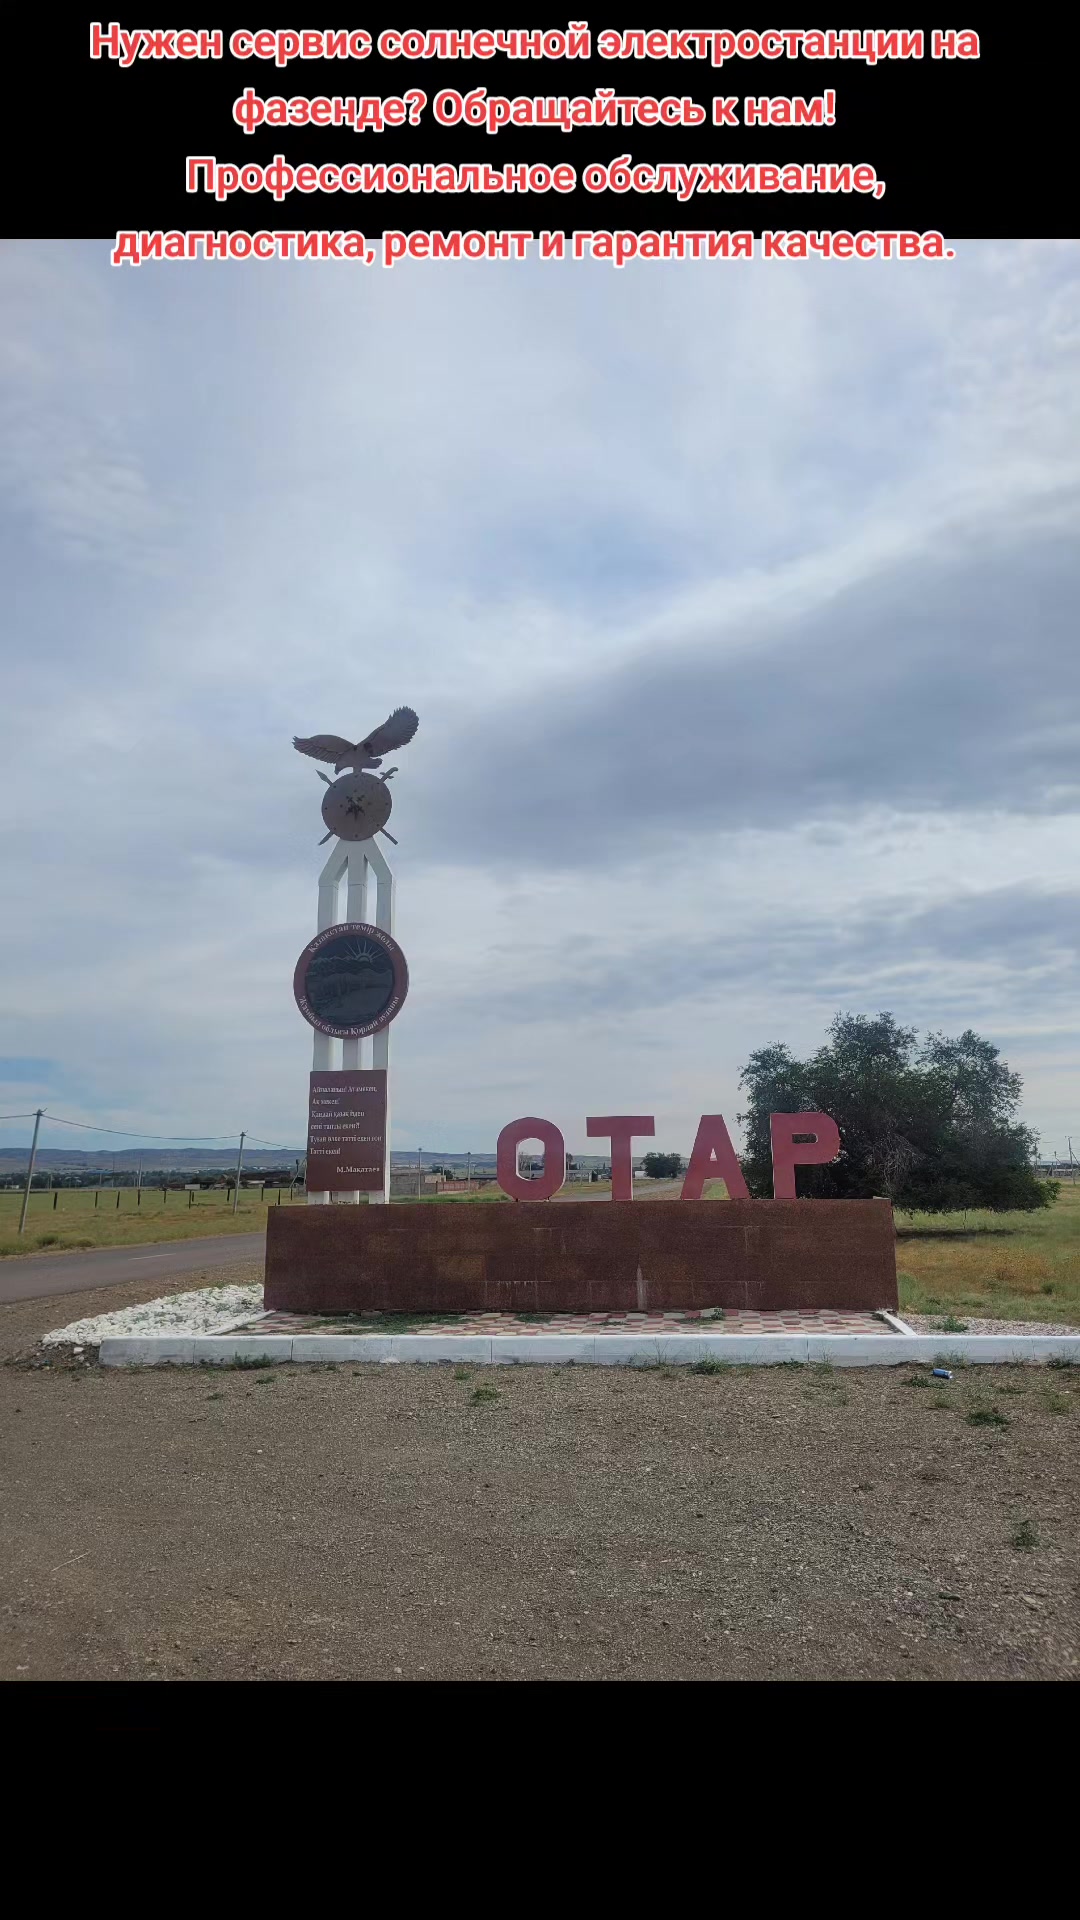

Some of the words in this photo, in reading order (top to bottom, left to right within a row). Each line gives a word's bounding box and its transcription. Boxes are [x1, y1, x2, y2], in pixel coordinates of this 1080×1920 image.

[351, 924, 374, 934] темір
[376, 930, 395, 951] жолы
[497, 1112, 841, 1201] ОТАР
